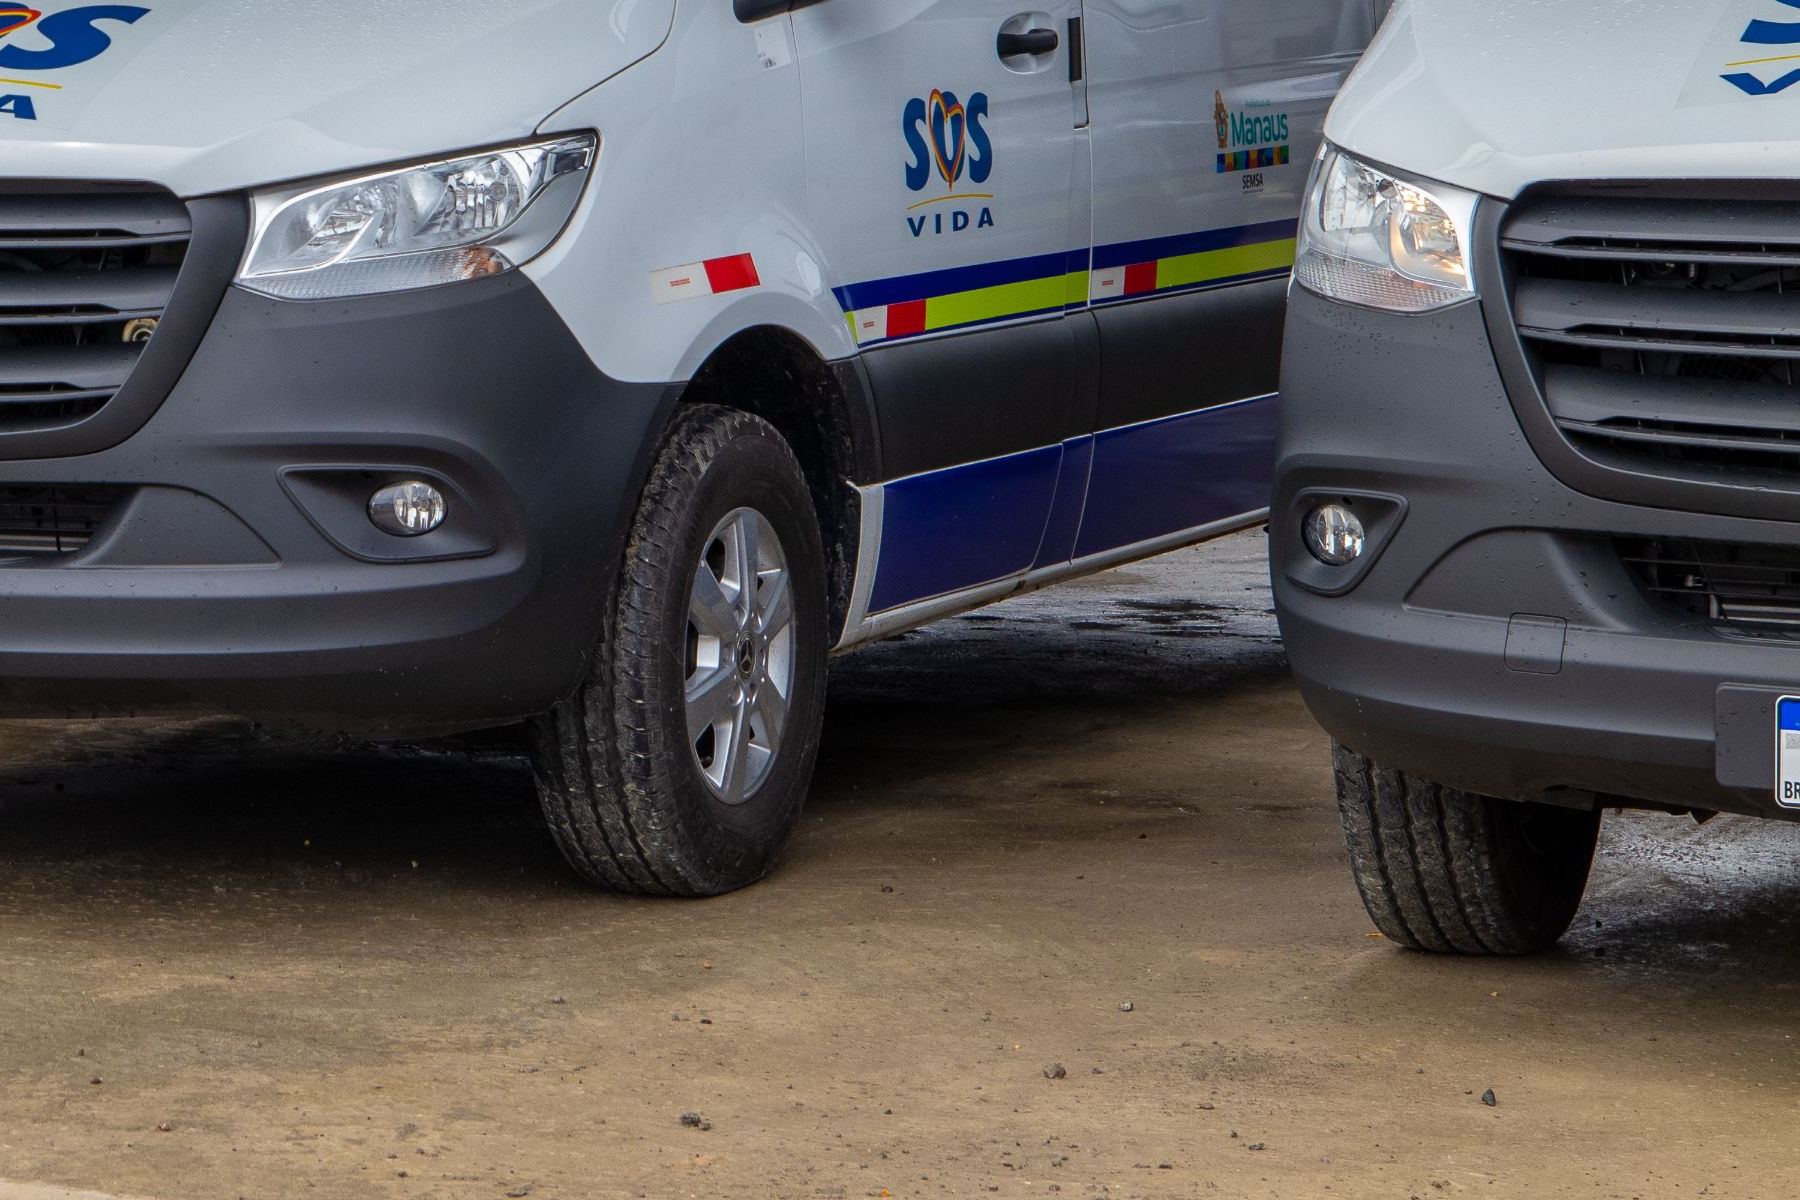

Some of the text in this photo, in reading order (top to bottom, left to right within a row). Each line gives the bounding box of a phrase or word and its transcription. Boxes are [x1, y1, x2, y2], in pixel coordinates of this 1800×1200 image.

[903, 89, 993, 192] SOS
[1230, 112, 1289, 147] Manaus
[1242, 173, 1264, 190] SEMSA
[906, 207, 995, 238] VIDA
